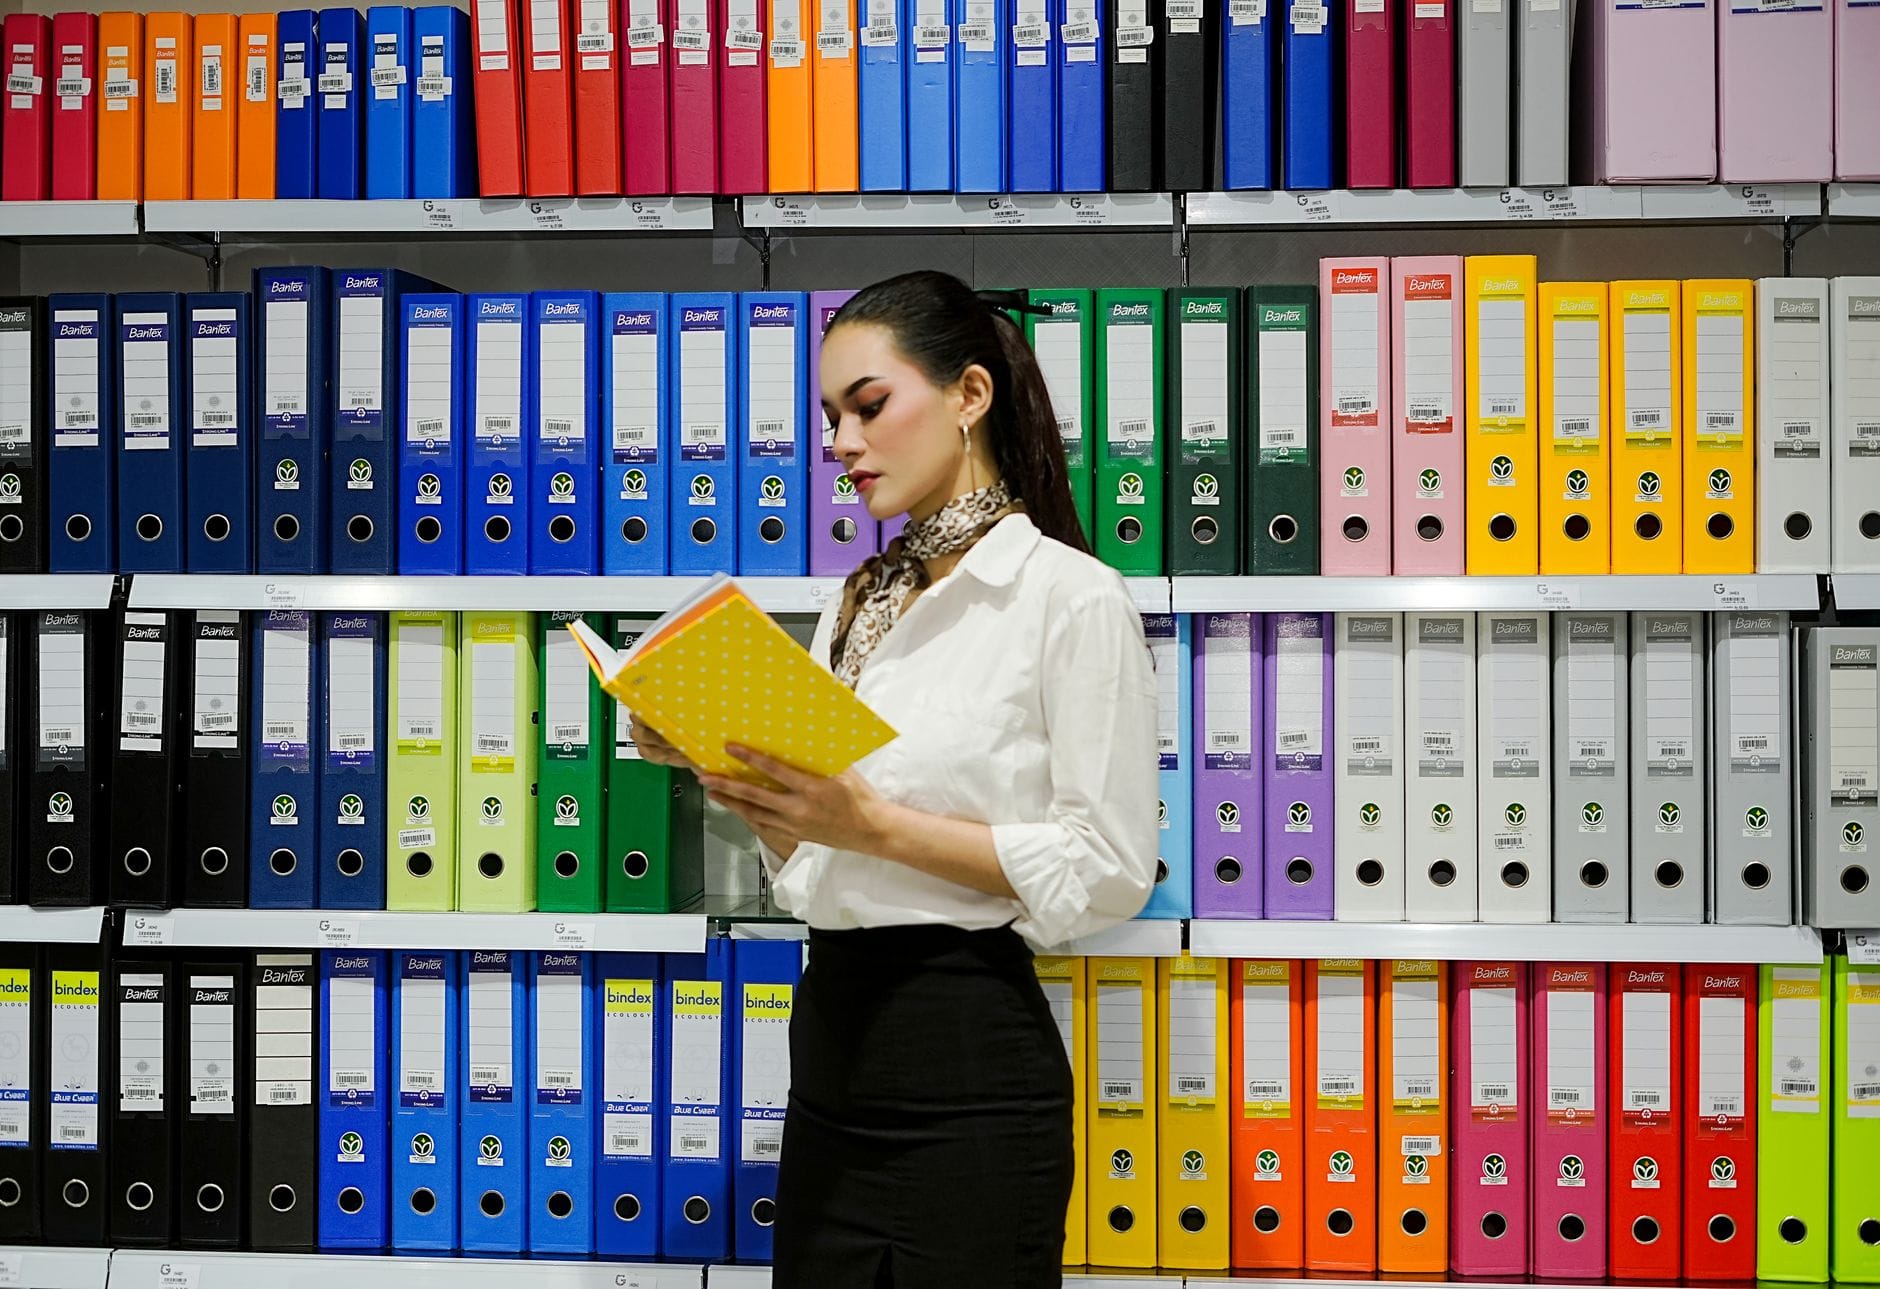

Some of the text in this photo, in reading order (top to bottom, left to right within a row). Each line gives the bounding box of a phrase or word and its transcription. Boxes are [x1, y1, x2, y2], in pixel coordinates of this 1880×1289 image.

[346, 277, 378, 288] Bantex
[1337, 272, 1373, 284] Bantex
[272, 281, 304, 293] Bantex
[1409, 279, 1445, 291] Bantex
[1484, 280, 1519, 291] Bantex
[1629, 293, 1665, 305] Bantex
[1703, 295, 1738, 306] Bantex
[482, 303, 516, 314] Bantex
[546, 303, 580, 314] Bantex
[1113, 304, 1148, 316] Bantex
[1186, 302, 1222, 314] Bantex
[1559, 301, 1595, 312] Bantex
[1780, 302, 1815, 314] Bantex
[1854, 300, 1880, 312] Bante
[414, 307, 447, 318] Bantex
[685, 310, 719, 322] Bantex
[754, 306, 789, 318] Bantex
[1265, 310, 1301, 322] Bantex
[617, 314, 651, 326] Bantex
[60, 324, 92, 336] Bantex
[129, 328, 162, 338] Bantex
[198, 324, 232, 335] Bantex
[45, 614, 79, 625] Bantex
[269, 610, 303, 621] Bantex
[334, 618, 368, 629] Bantex
[478, 623, 510, 633] Bantex
[1283, 617, 1319, 629] Bantex
[1352, 621, 1387, 633] Bantex
[1424, 622, 1459, 634] Bantex
[1496, 623, 1531, 634] Bantex
[1573, 622, 1608, 633] Bantex
[1653, 622, 1688, 633] Bantex
[1735, 618, 1771, 629] Bantex
[128, 628, 160, 639] Bantex
[201, 625, 234, 637] Bantex
[1836, 648, 1871, 660] Bantex
[474, 952, 506, 963] Bantex
[544, 955, 577, 966] Bantex
[335, 958, 368, 969] Bantex
[409, 959, 442, 970] Bantex
[1175, 959, 1209, 971] Bantex
[1398, 961, 1432, 973] Bantex
[262, 969, 305, 983] Bantex
[1103, 966, 1137, 977] Bantex
[1249, 965, 1283, 976] Bantex
[1475, 967, 1510, 979] Bantex
[1552, 970, 1588, 982] Bantex
[1628, 971, 1664, 982] Bantex
[0, 978, 28, 992] ndex
[55, 980, 98, 995] bindex
[1704, 977, 1740, 988] Bantex
[125, 989, 159, 1000] Bantex
[1778, 984, 1815, 995] Bantex
[196, 991, 229, 1002] Bantex
[608, 988, 651, 1004] bindex
[676, 989, 720, 1006] bindex
[746, 993, 790, 1009] bindex
